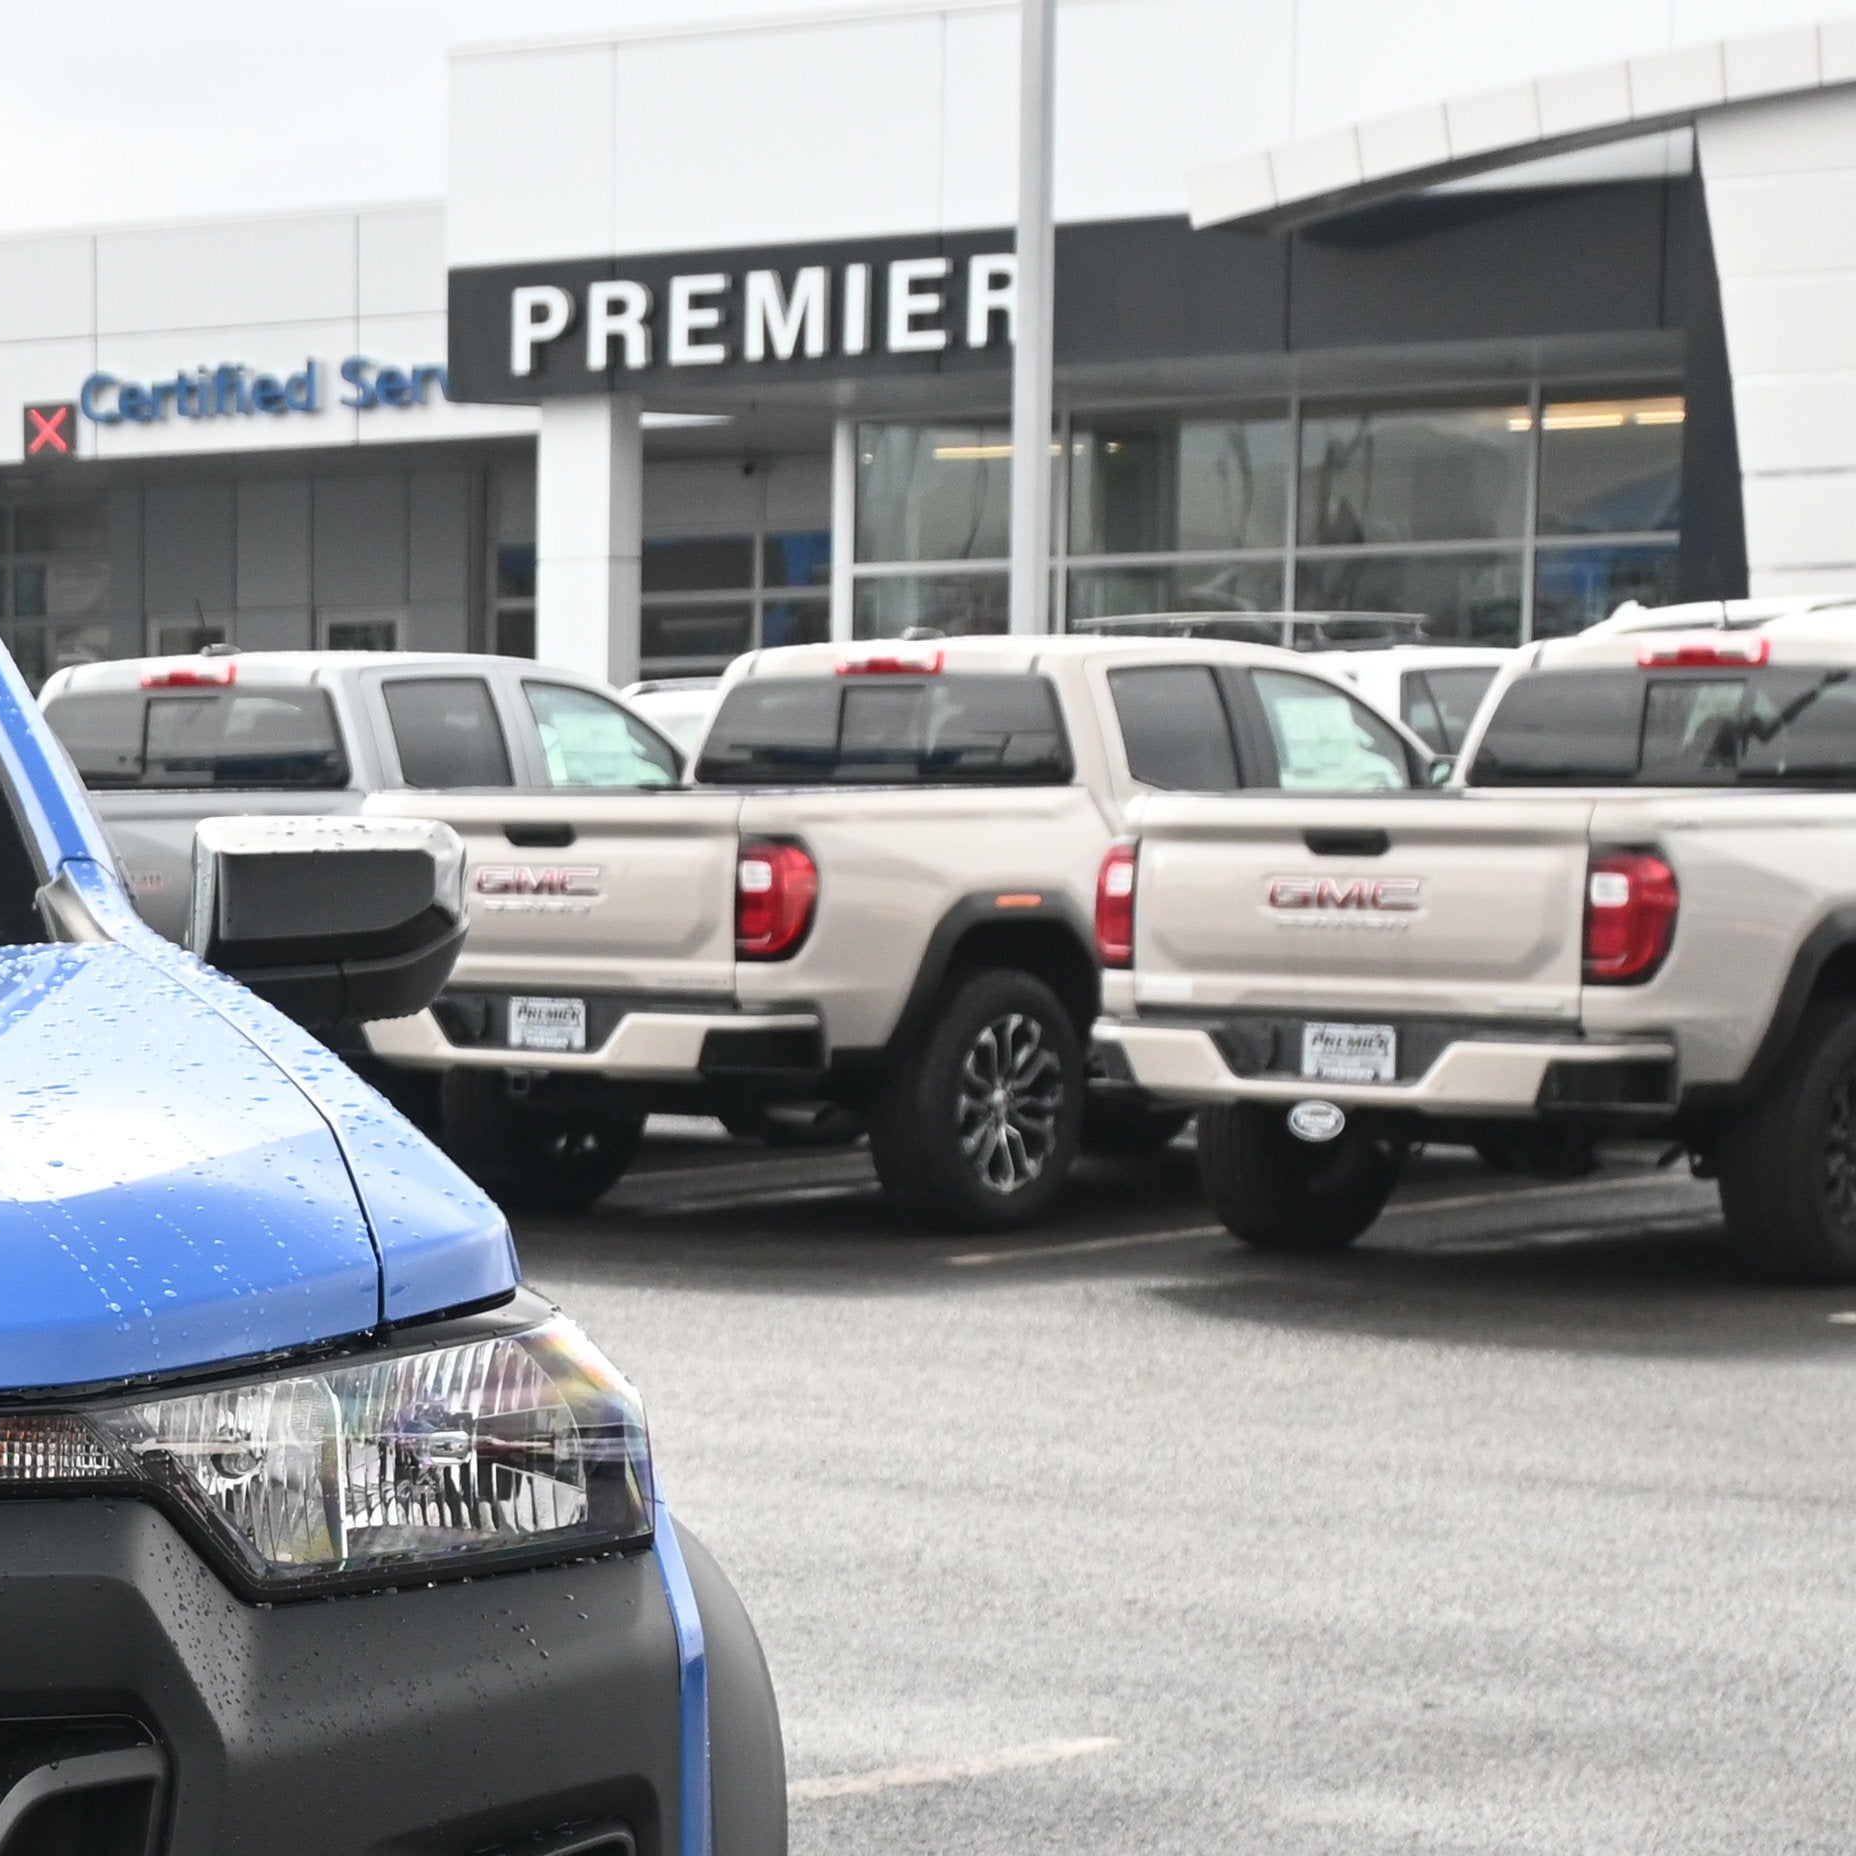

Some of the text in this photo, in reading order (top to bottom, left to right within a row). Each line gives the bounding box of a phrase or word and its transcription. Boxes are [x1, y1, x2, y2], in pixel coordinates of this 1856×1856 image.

[510, 252, 1017, 376] PREMIER
[81, 357, 318, 424] Certified
[474, 864, 602, 896] GMC
[1267, 876, 1420, 912] GMC
